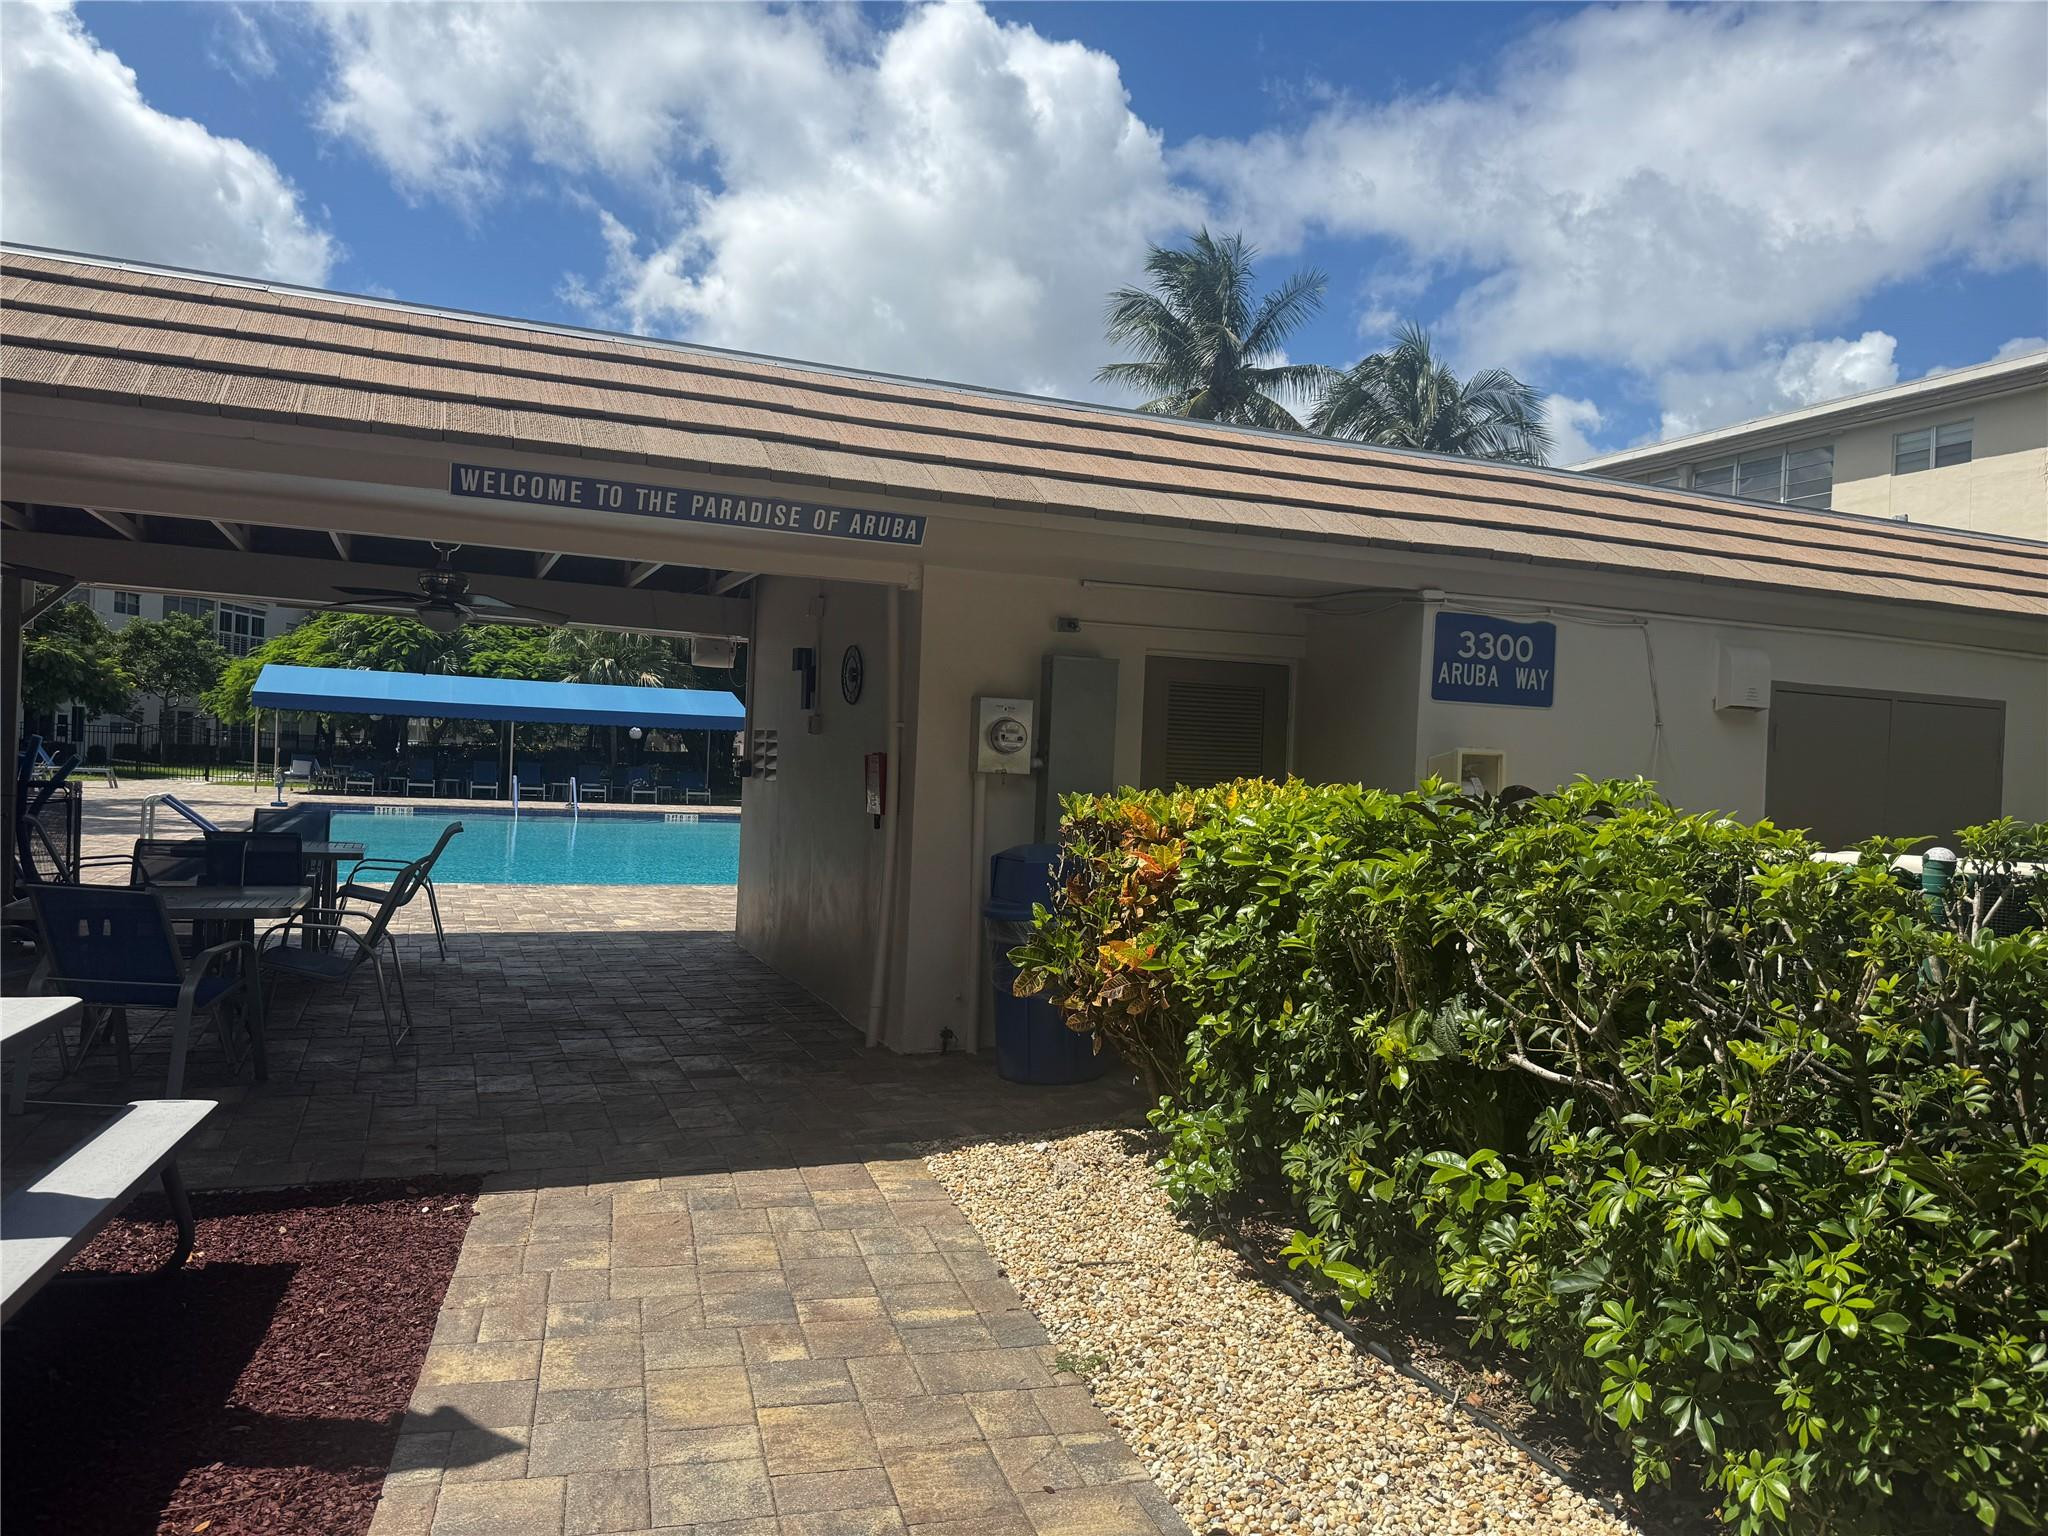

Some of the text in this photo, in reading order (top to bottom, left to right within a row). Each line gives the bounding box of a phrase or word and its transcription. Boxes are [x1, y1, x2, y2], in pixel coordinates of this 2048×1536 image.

[460, 467, 918, 541] WELCOME TO THE PARADISE OF ARUBA
[1457, 631, 1533, 662] 3300
[1438, 662, 1549, 691] ARUBA WAY
